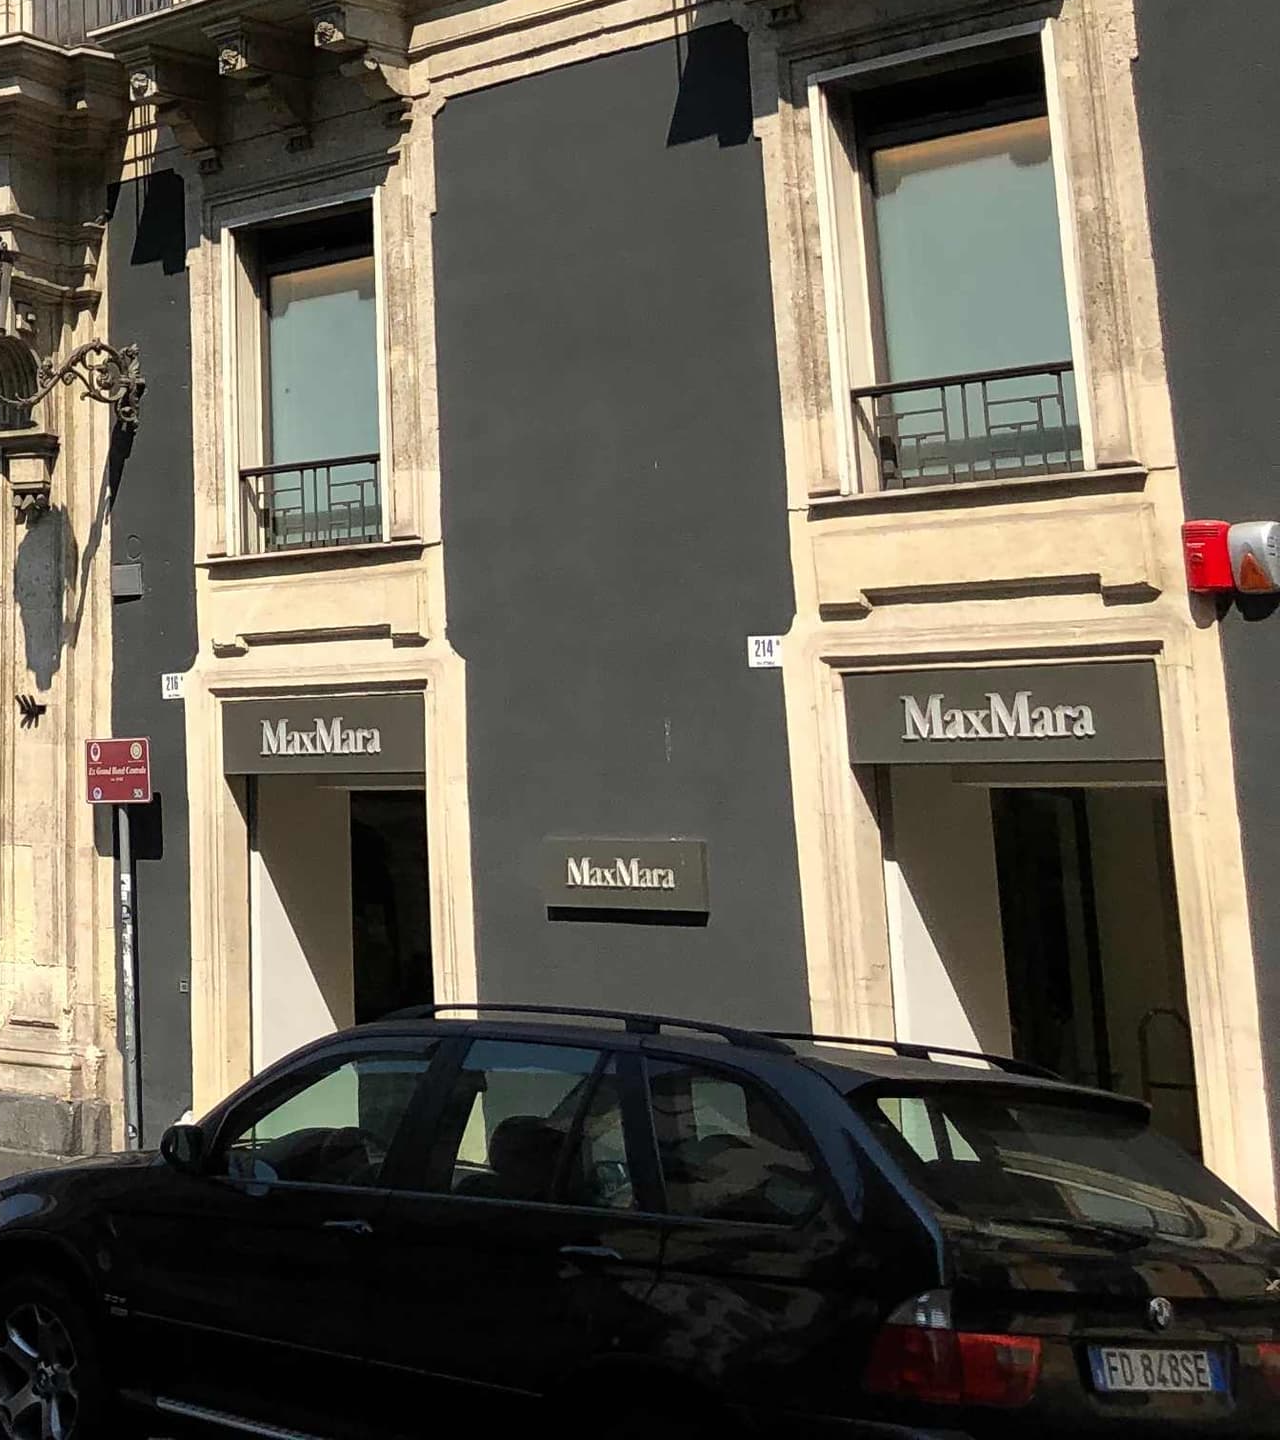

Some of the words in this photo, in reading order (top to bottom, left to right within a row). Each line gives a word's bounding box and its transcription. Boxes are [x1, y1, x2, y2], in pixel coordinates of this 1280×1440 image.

[754, 639, 774, 658] 214
[899, 690, 1097, 740] MaxMara
[259, 716, 382, 756] MaxMara
[565, 856, 676, 889] MaxMara
[1105, 1351, 1135, 1386] FD
[1140, 1352, 1210, 1388] 848SE
